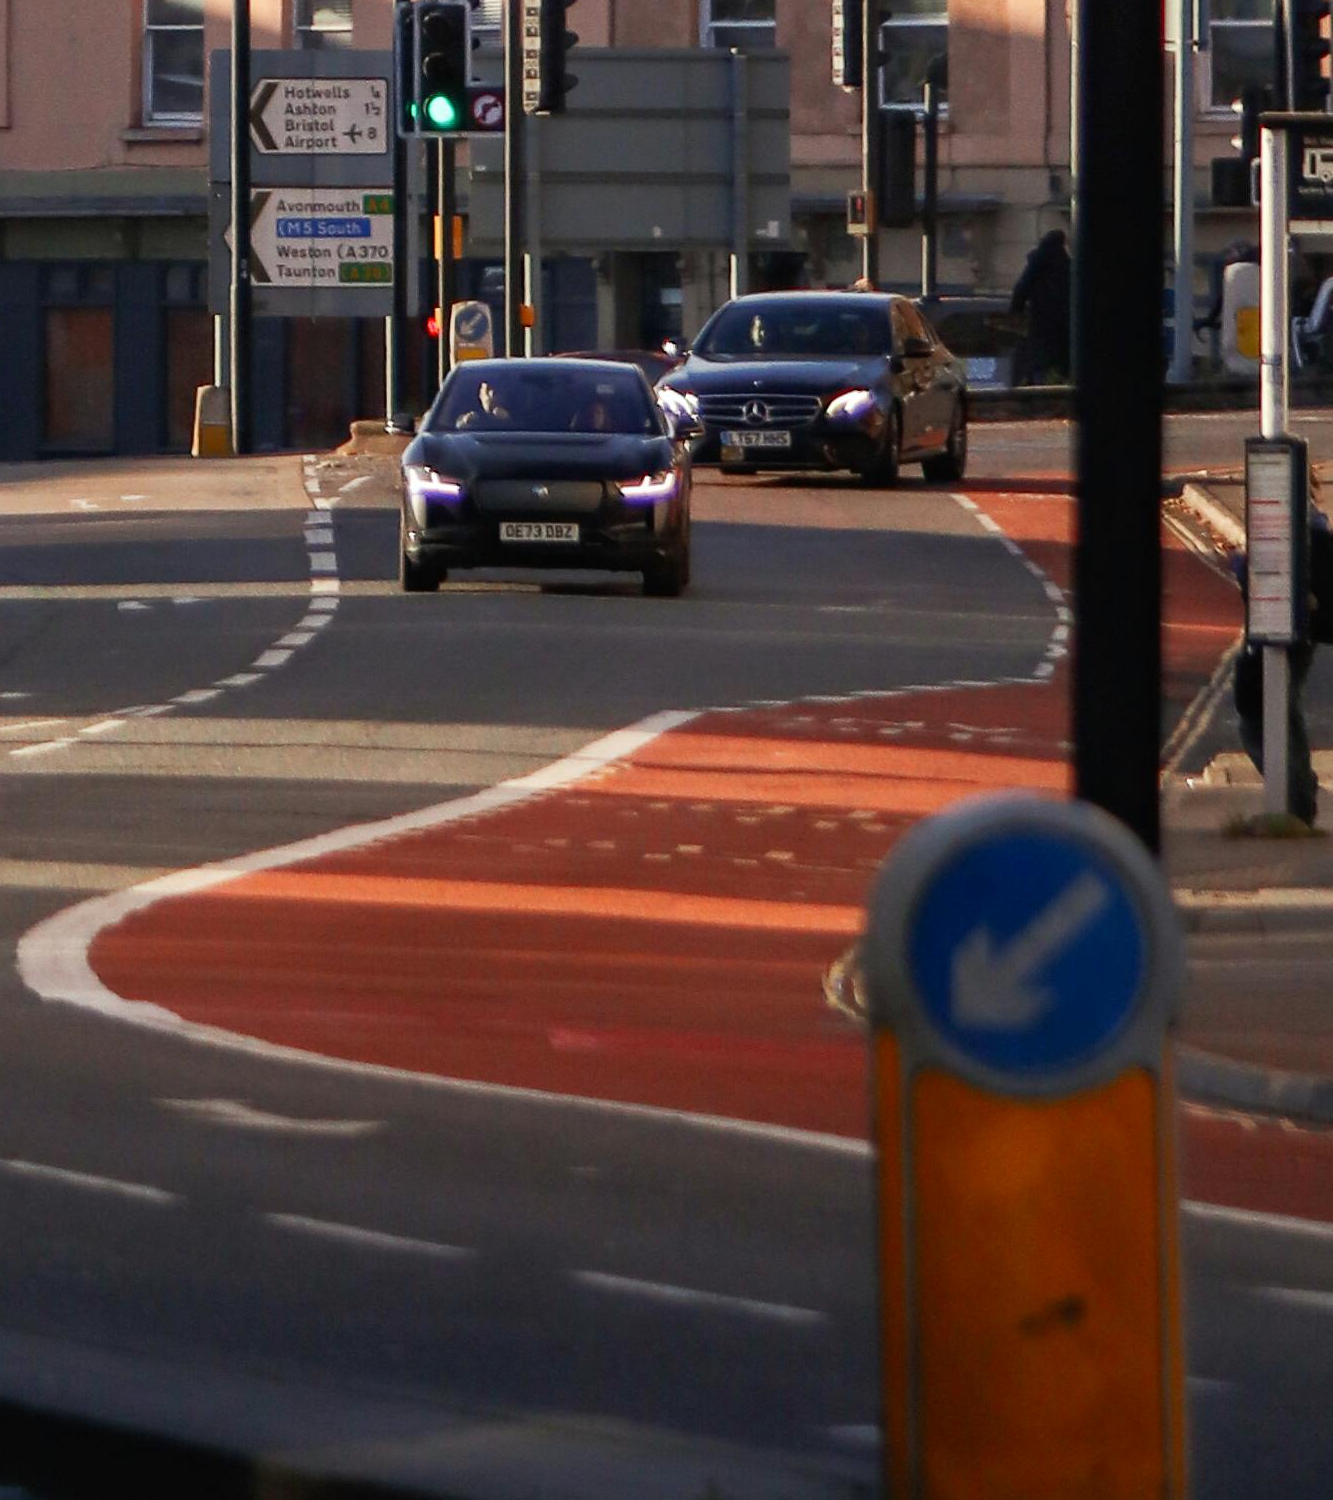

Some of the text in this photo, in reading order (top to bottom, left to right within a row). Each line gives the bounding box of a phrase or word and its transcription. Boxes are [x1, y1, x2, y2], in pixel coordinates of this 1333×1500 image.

[284, 86, 350, 99] Hotwells
[284, 102, 336, 115] Ashton
[285, 119, 335, 132] Bristol
[284, 137, 337, 149] Airport
[276, 200, 361, 213] Avonmouth
[276, 246, 331, 259] Weston
[276, 265, 336, 278] Taunton
